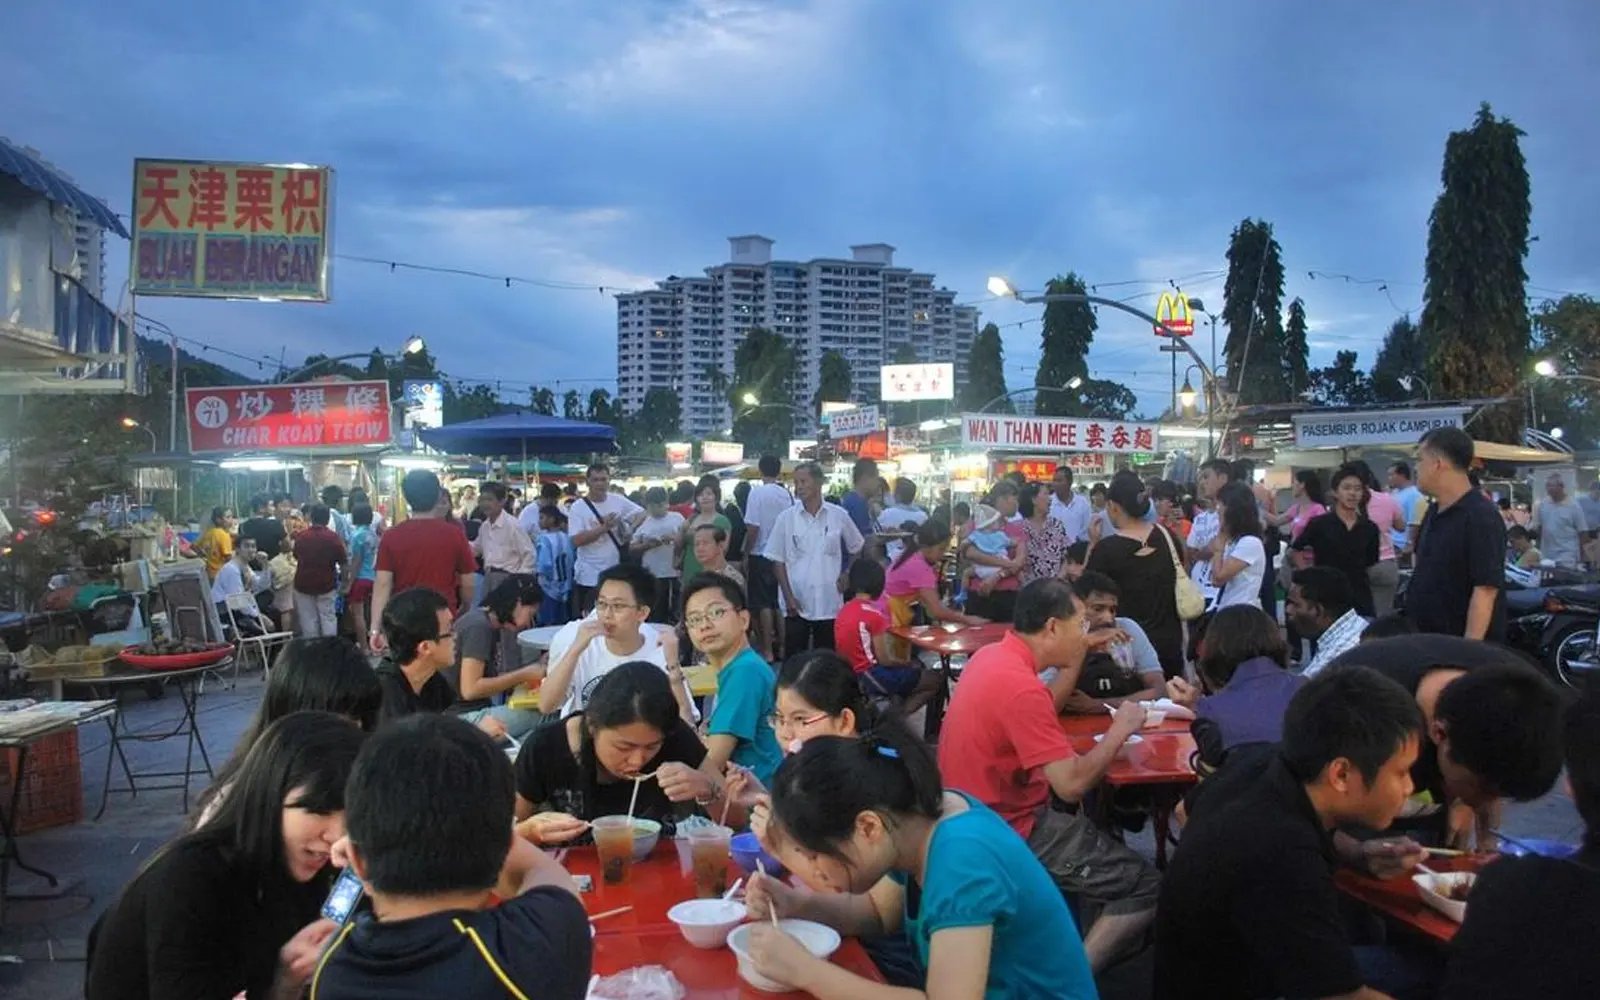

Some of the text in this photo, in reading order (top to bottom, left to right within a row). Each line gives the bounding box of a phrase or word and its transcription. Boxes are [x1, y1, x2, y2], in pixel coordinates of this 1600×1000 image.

[138, 237, 196, 281] BUAH
[203, 409, 220, 424] 71
[1302, 422, 1358, 437] PASEMBUR
[1362, 421, 1396, 435] ROJAK
[222, 421, 383, 446] CHAR KOAY TEOW
[968, 419, 999, 443] WAN
[1004, 421, 1043, 445] THAN
[1047, 422, 1077, 447] MEE
